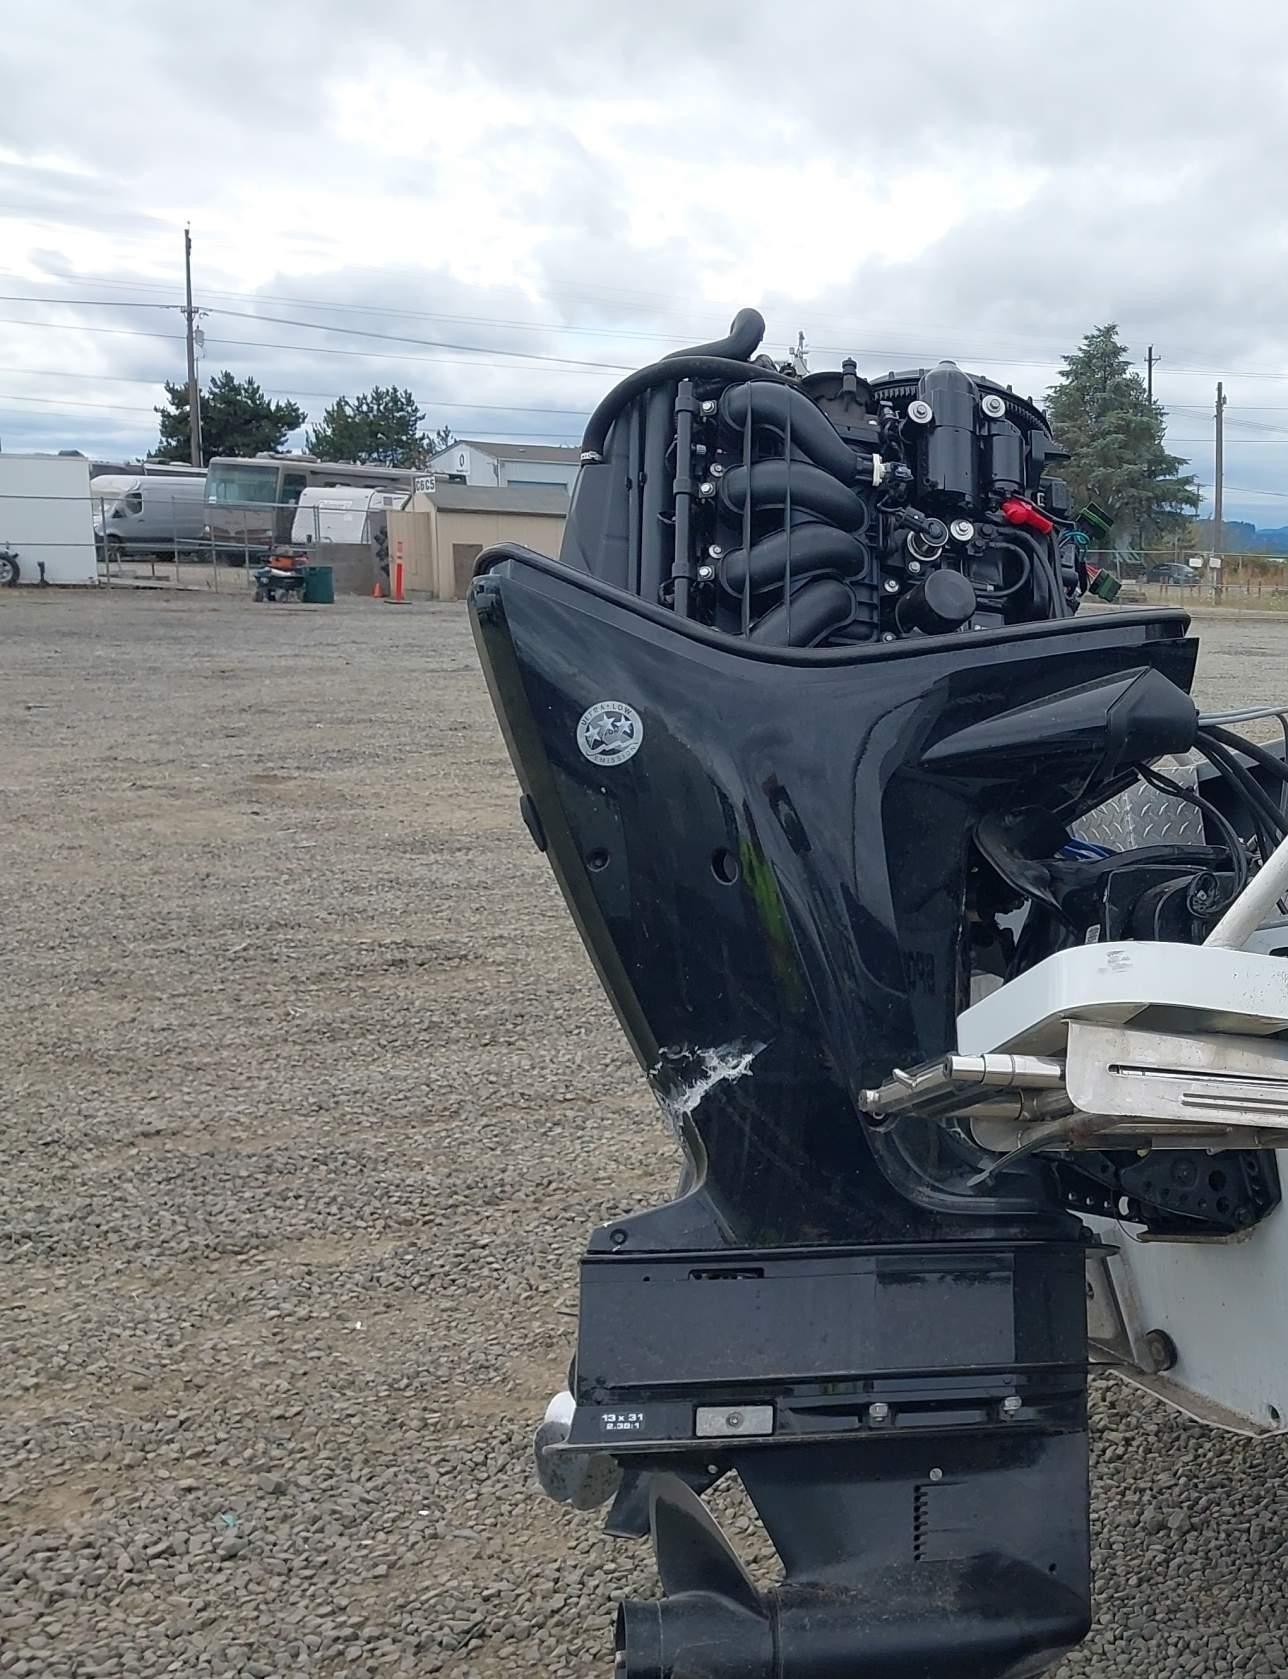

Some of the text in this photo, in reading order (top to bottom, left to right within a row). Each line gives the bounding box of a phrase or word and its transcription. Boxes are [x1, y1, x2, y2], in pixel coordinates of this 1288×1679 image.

[612, 703, 632, 715] LOW
[601, 1413, 616, 1422] 13
[628, 1413, 643, 1421] 31
